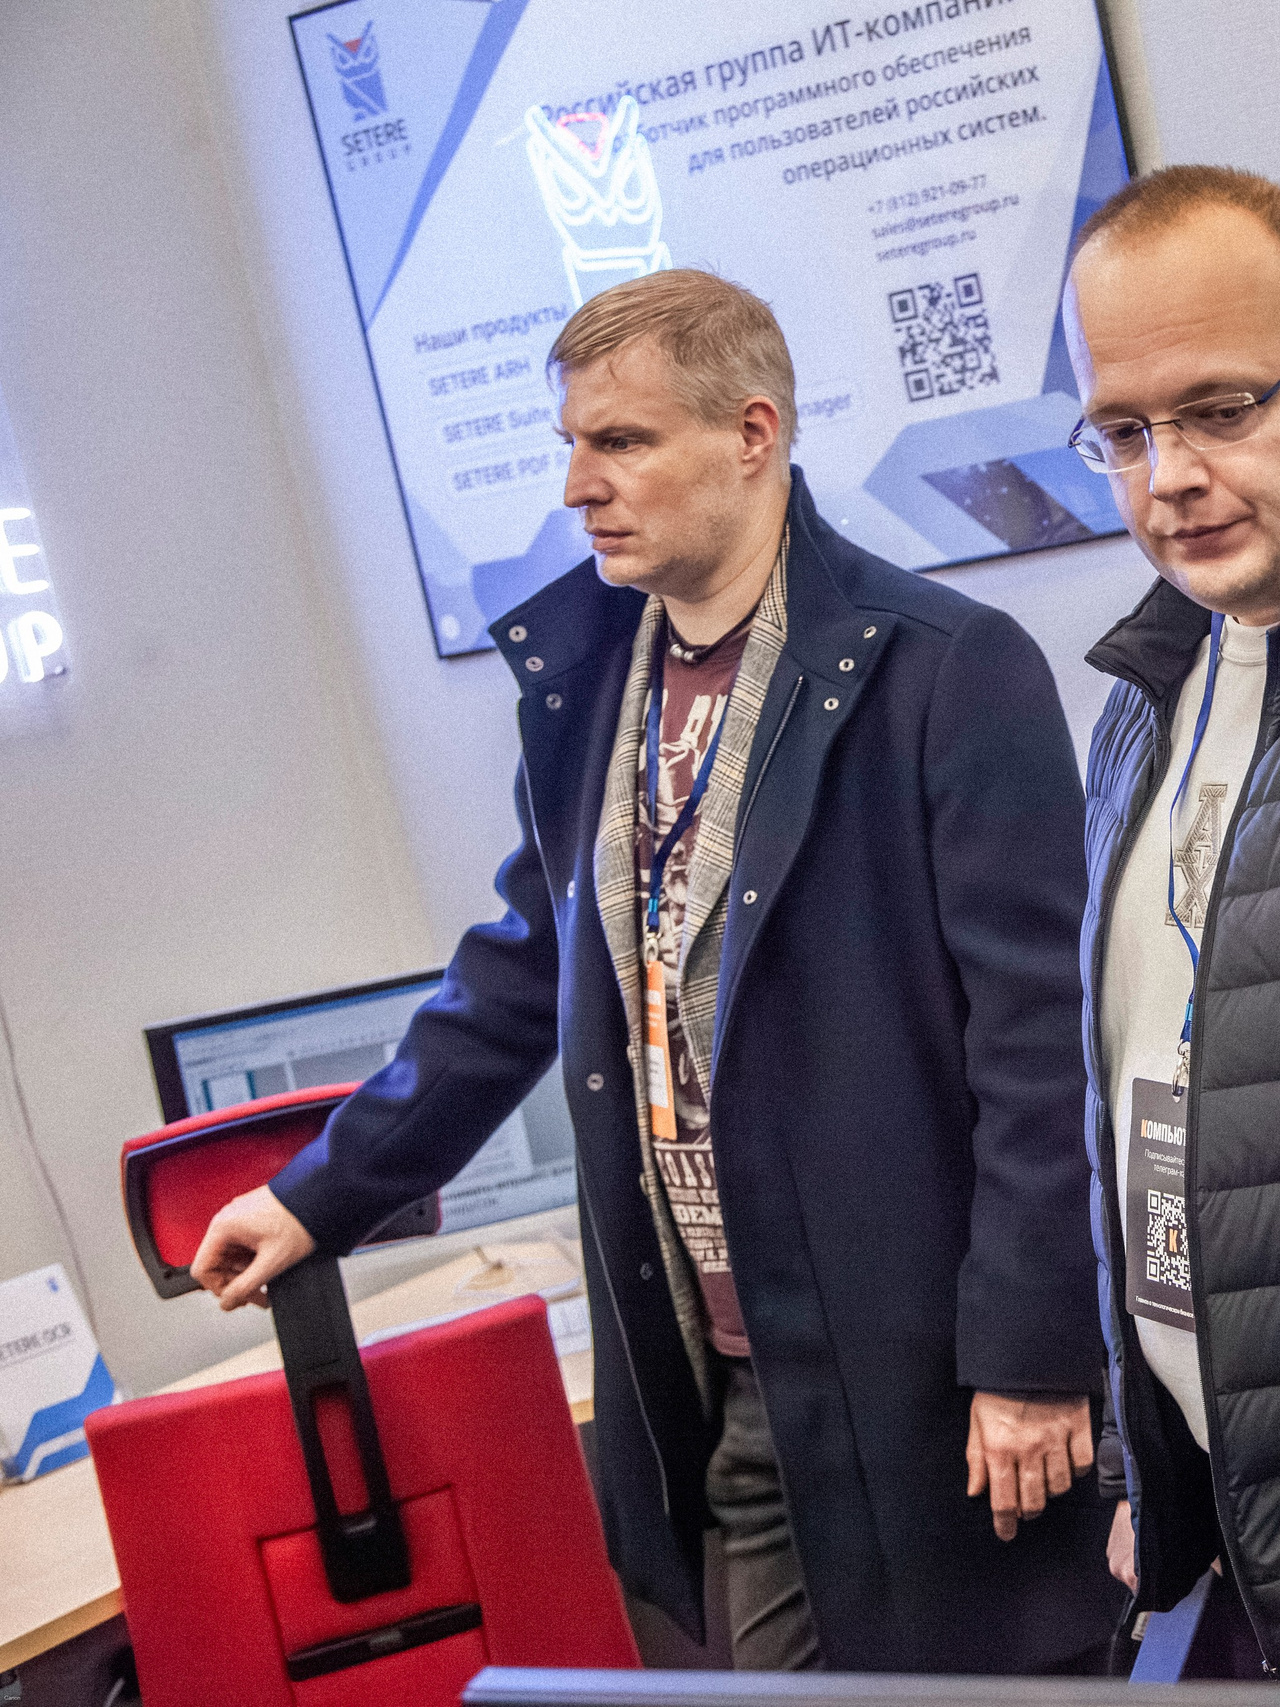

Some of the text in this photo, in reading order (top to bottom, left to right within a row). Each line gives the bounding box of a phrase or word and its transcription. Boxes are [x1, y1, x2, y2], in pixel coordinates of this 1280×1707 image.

[704, 40, 804, 92] группа
[811, 0, 1012, 56] ИТ-компан
[713, 69, 876, 128] программного
[882, 26, 1032, 82] обеспечения
[341, 119, 408, 156] SETERE
[687, 65, 1040, 175] для пользователей российских
[783, 106, 1047, 184] операционных систем.
[413, 302, 569, 353] Наши продукты
[1140, 1119, 1186, 1147] КОМПЬЮТ
[1144, 1148, 1185, 1167] Подписывайтес
